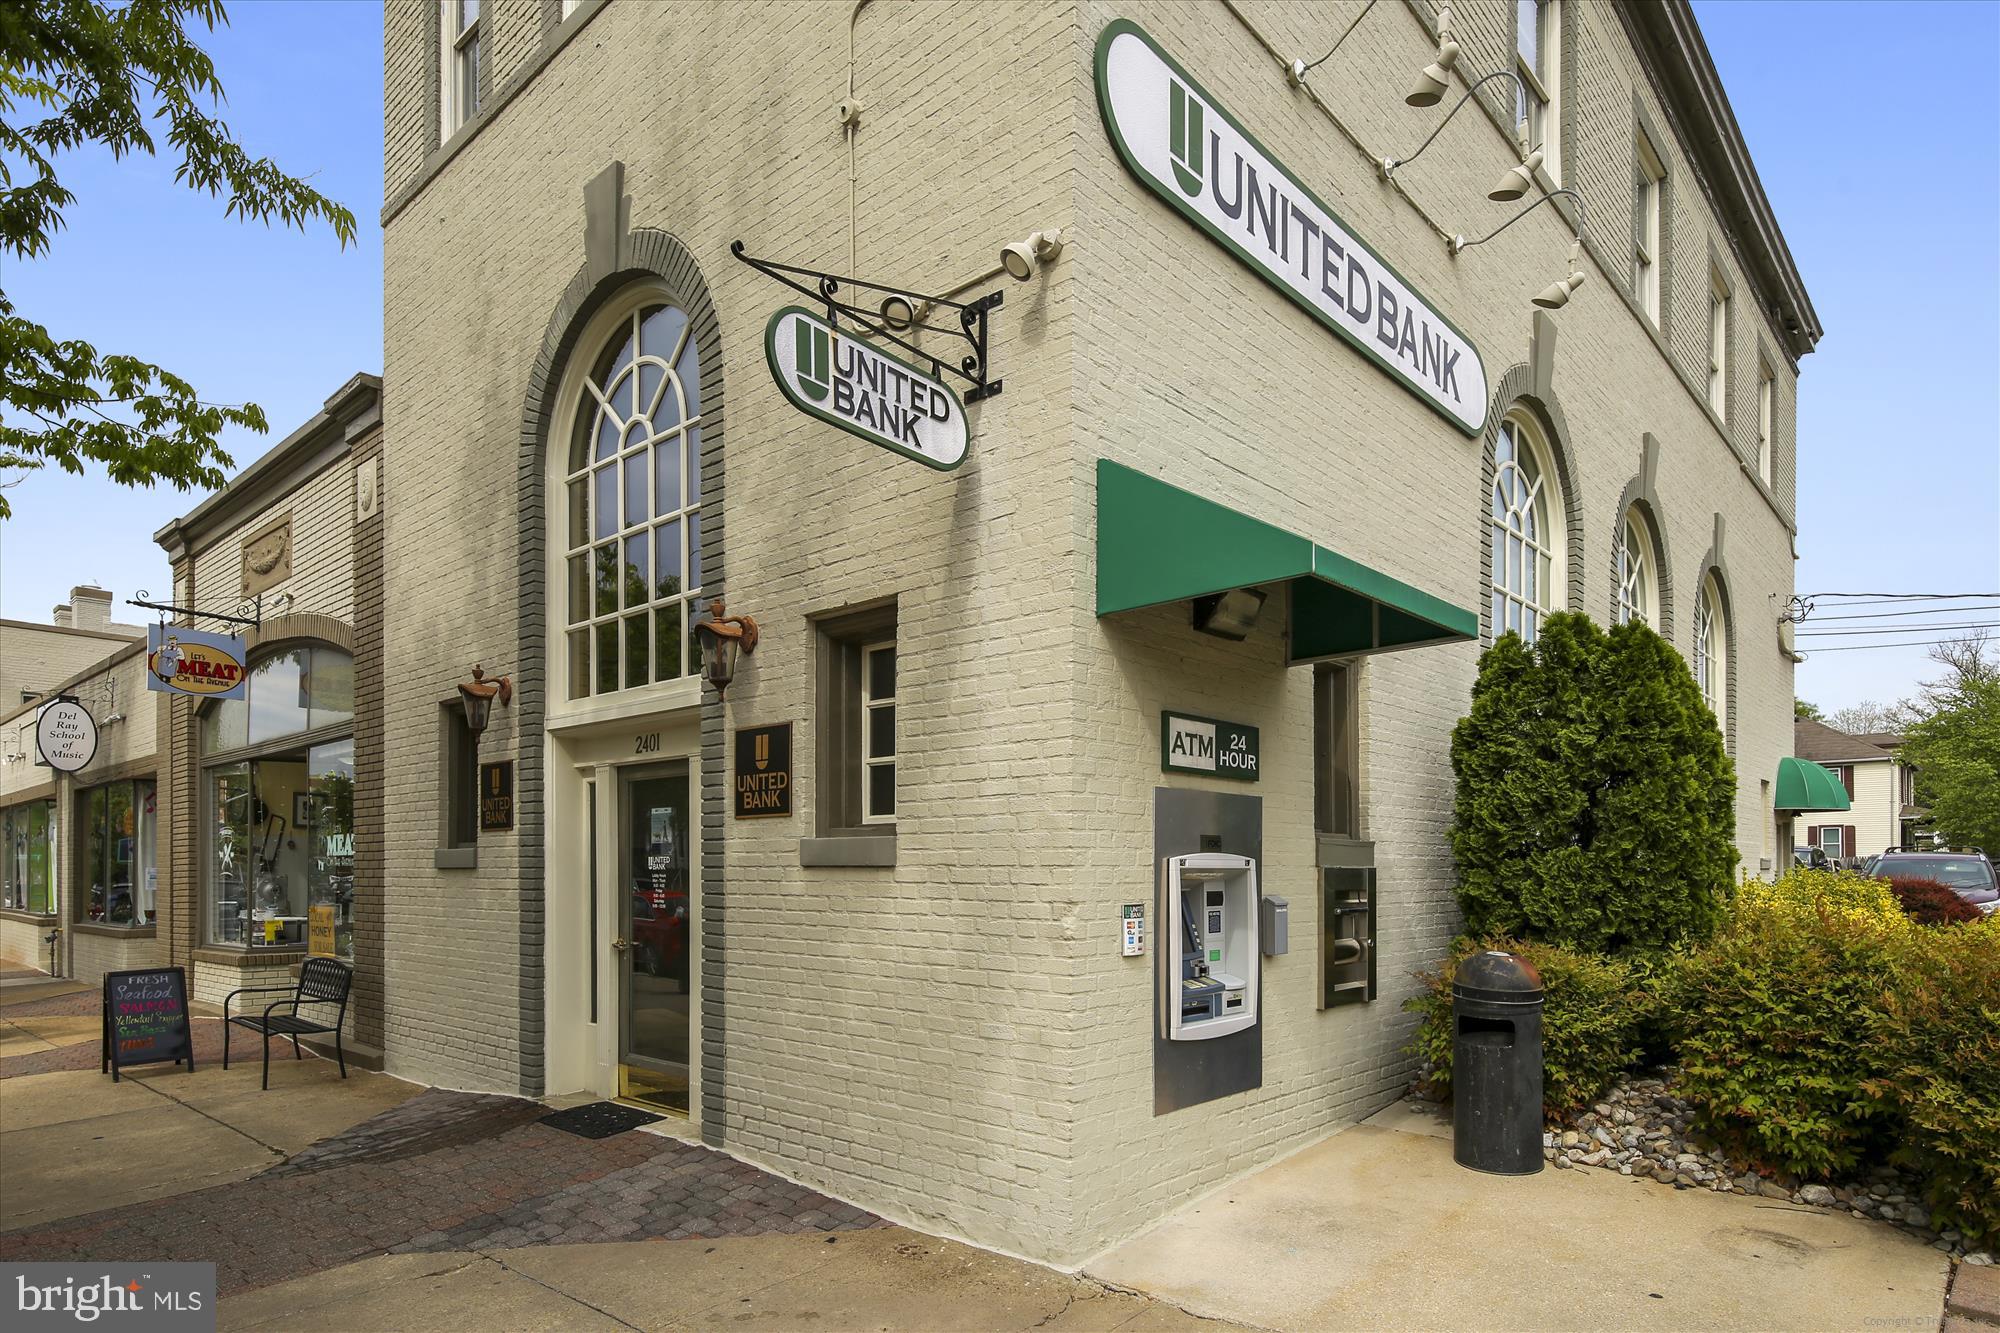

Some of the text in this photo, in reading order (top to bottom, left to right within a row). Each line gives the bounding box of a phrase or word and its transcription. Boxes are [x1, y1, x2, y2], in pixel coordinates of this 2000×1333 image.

[1210, 129, 1462, 404] UNITED BANK
[832, 336, 950, 422] UNITED
[832, 375, 922, 449] BANK
[176, 659, 238, 681] MEAT
[58, 711, 77, 720] Del
[56, 721, 79, 731] Ray
[49, 730, 86, 740] School
[635, 732, 660, 754] 2401
[1230, 733, 1247, 751] 24
[62, 741, 74, 751] of
[1171, 730, 1214, 759] ATM
[50, 750, 85, 760] Music
[1219, 750, 1257, 770] HOUR
[737, 771, 788, 792] UNITED
[482, 796, 511, 812] UNITED
[743, 789, 781, 809] BANK
[485, 810, 507, 825] BANK
[652, 856, 671, 864] UNITED
[311, 925, 332, 938] HONEY
[128, 975, 169, 984] FRESH
[117, 985, 173, 1000] Seafood
